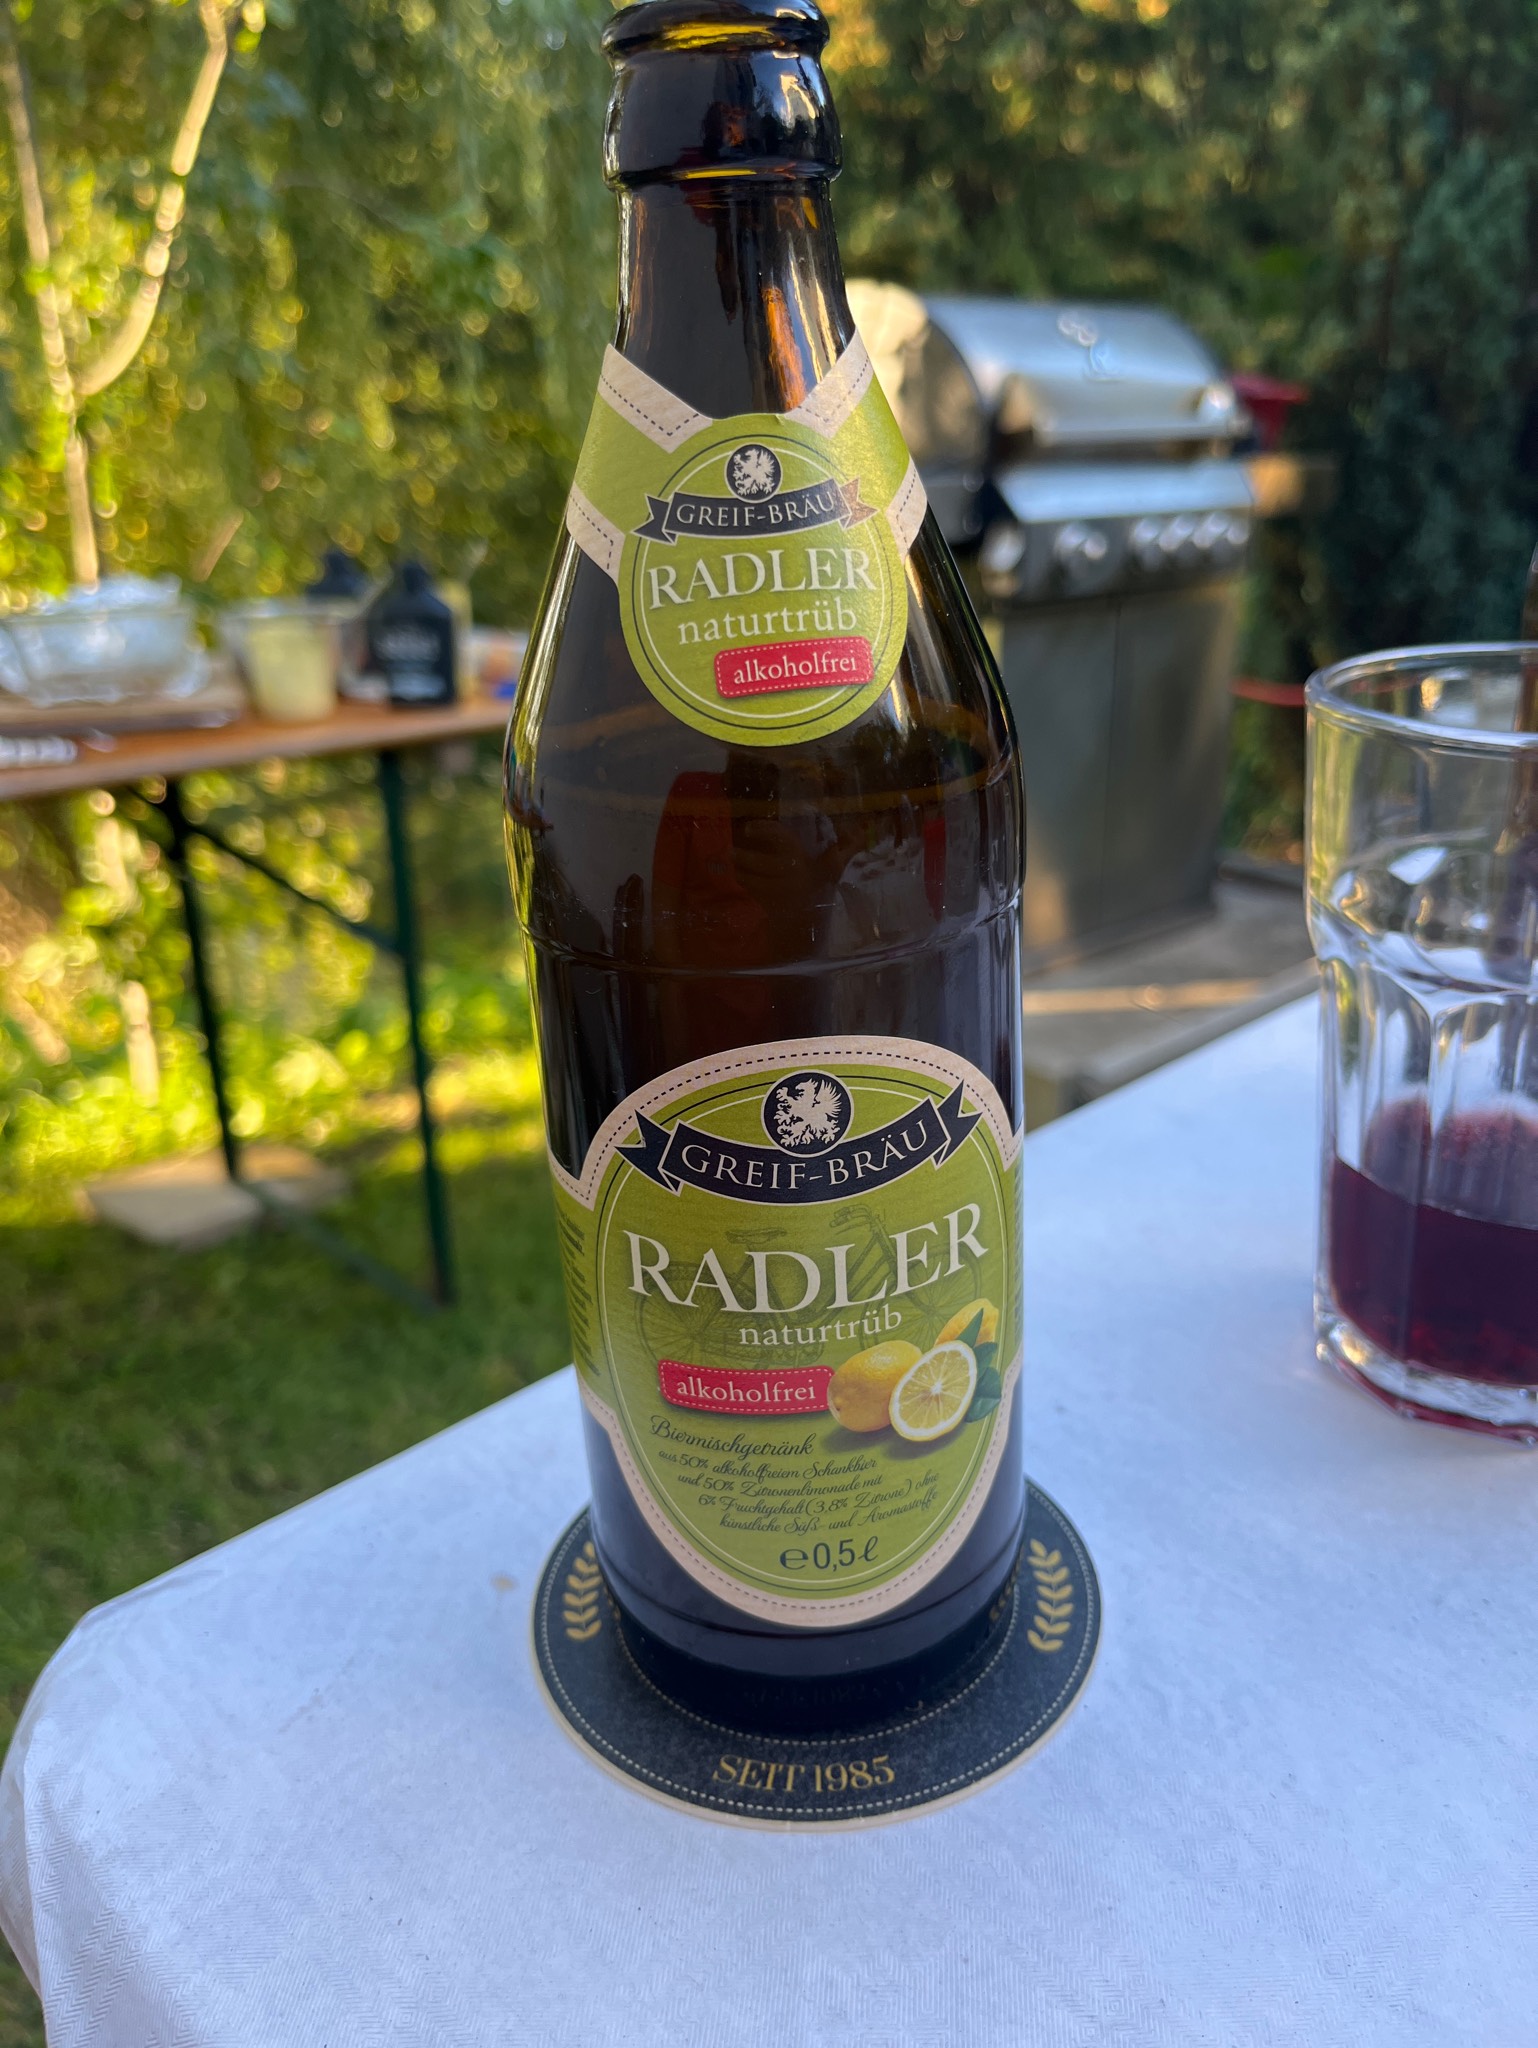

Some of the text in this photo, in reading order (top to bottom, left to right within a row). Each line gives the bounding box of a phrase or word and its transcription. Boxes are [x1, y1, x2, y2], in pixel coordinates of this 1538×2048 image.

[676, 491, 834, 527] GREIF-BRÄU
[648, 548, 877, 610] RADLER
[678, 595, 858, 646] naturtrüb
[733, 651, 857, 684] alkoholfrei
[680, 1118, 930, 1191] GREIF-BRÄU
[622, 1202, 989, 1314] RADLER
[738, 1304, 903, 1347] naturtrüb
[676, 1377, 817, 1404] alkoholfrei
[650, 1415, 816, 1460] Biermischgetränk
[658, 1450, 877, 1484] aus 50% alkoholfreiem Schankbier
[677, 1473, 883, 1498] und 50% Zitronenlimonade mit
[698, 1494, 717, 1506] 6%
[719, 1513, 781, 1532] künstliche
[828, 1510, 858, 1530] und
[712, 1754, 895, 1793] SEIT 1985
